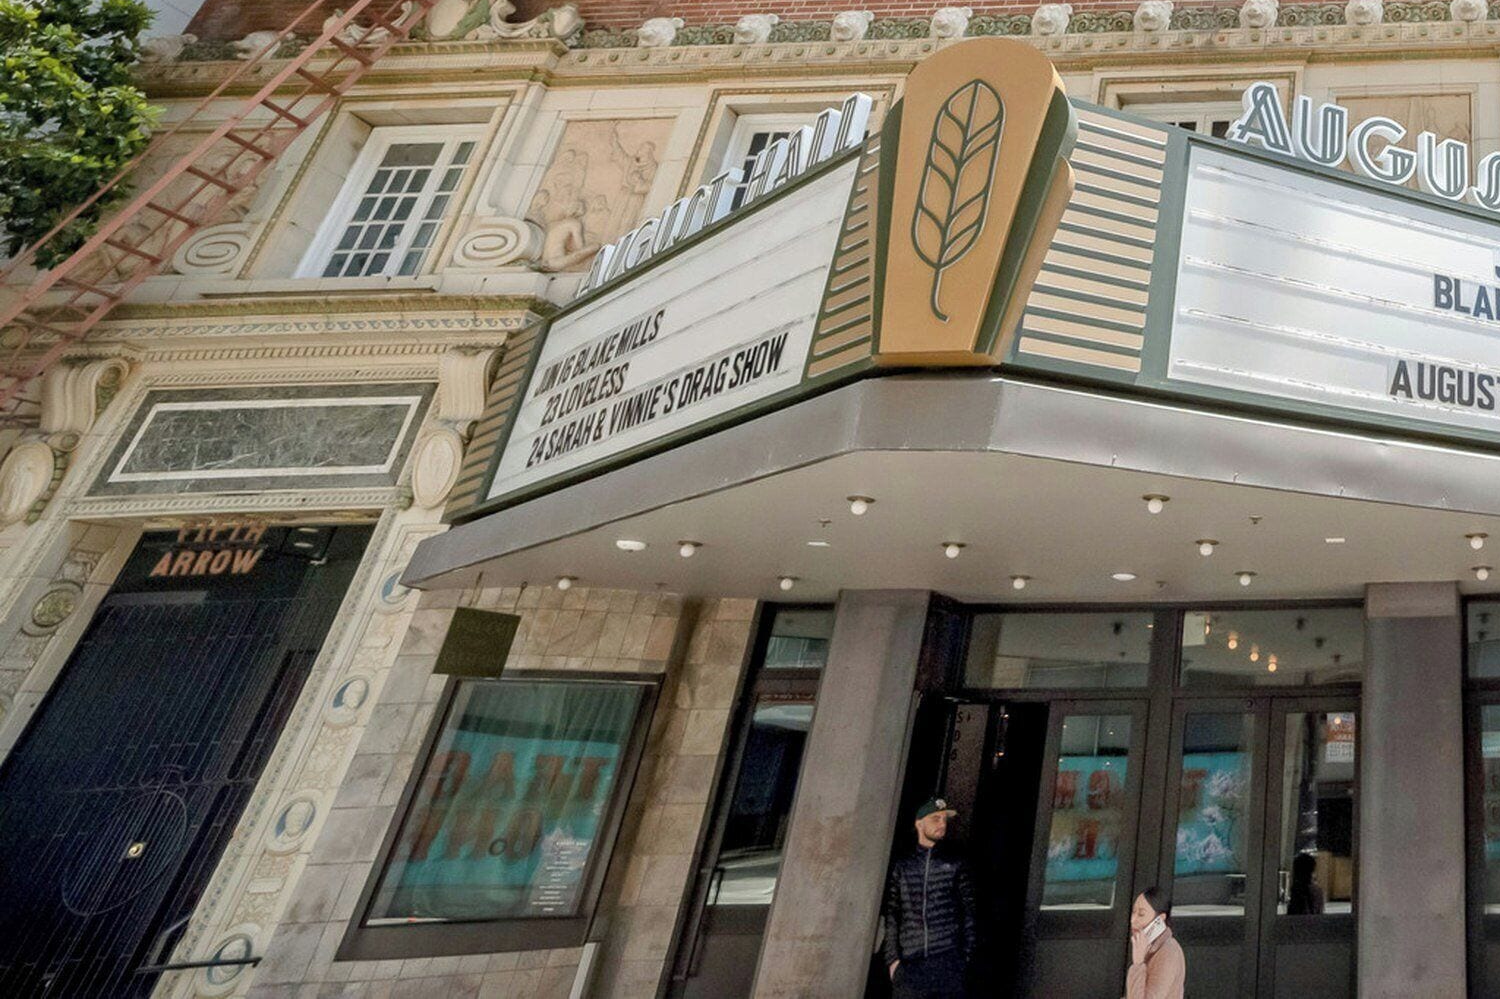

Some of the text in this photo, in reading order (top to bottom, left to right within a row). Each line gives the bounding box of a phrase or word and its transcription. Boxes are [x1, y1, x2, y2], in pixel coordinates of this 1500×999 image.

[533, 309, 666, 398] JUN 16 BLAKE MILLS
[526, 332, 790, 469] 24 SARAH & VINNIE'S DRAG SHOW
[540, 361, 631, 428] 23 LOVELESS
[149, 549, 266, 578] ARROW
